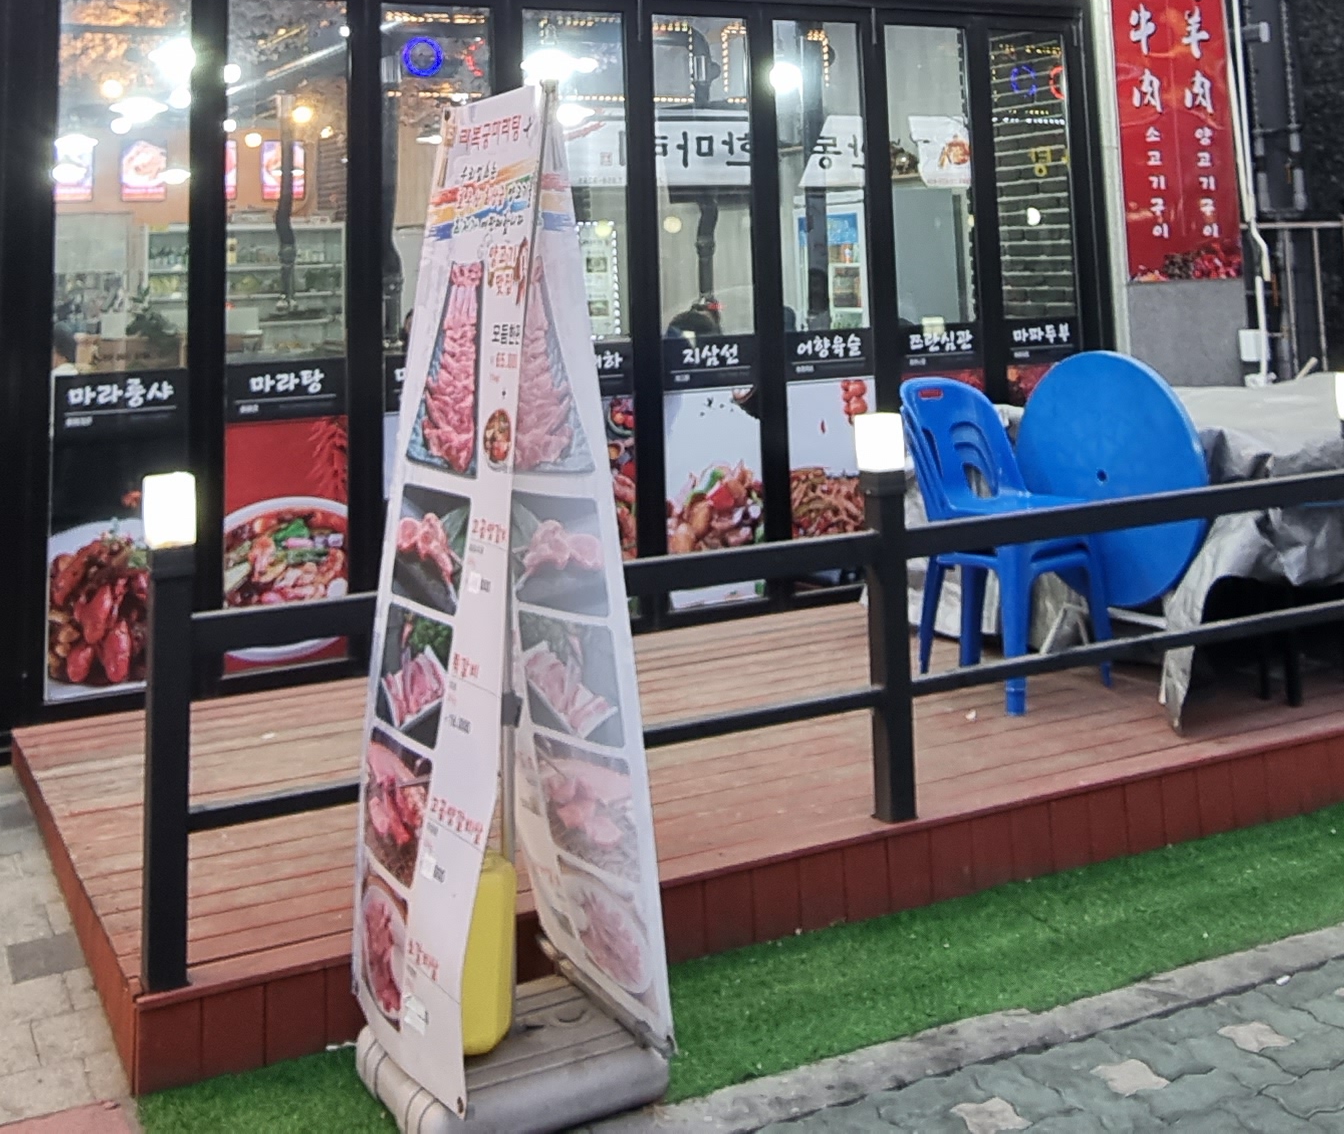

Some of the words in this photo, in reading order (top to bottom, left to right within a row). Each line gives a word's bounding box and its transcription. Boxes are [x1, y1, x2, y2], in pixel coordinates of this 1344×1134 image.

[1145, 126, 1169, 240] 소고기구이
[1194, 127, 1219, 239] 양고기구이
[1012, 324, 1071, 345] 마파두부
[682, 344, 739, 366] 지삼선
[250, 369, 325, 394] 마라탕
